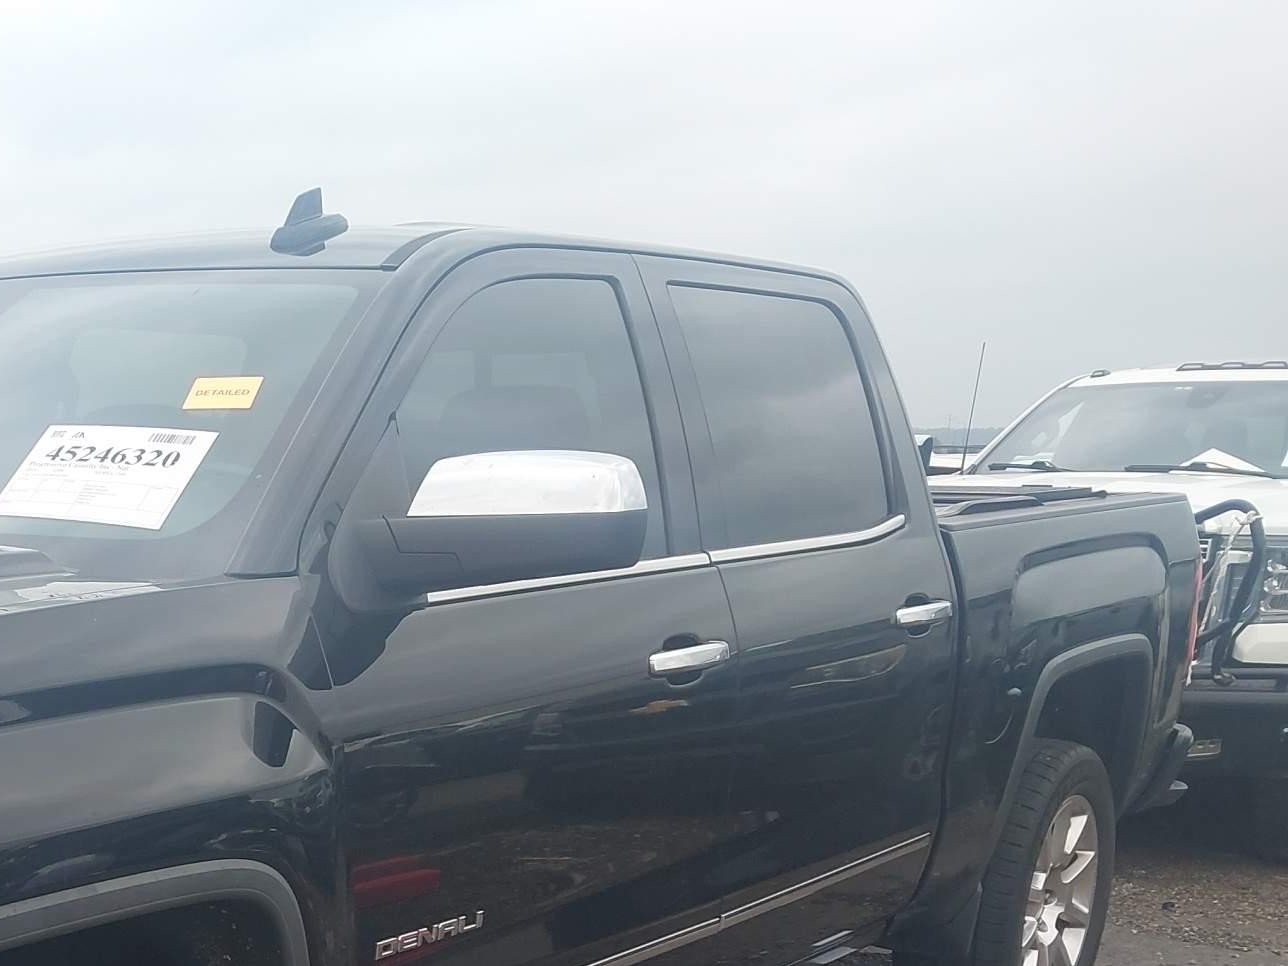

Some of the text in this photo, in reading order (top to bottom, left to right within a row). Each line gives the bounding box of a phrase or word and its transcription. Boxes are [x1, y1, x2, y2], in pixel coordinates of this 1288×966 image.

[195, 388, 251, 397] DETAILED
[45, 444, 181, 469] 45246320
[375, 910, 486, 961] DENALI
